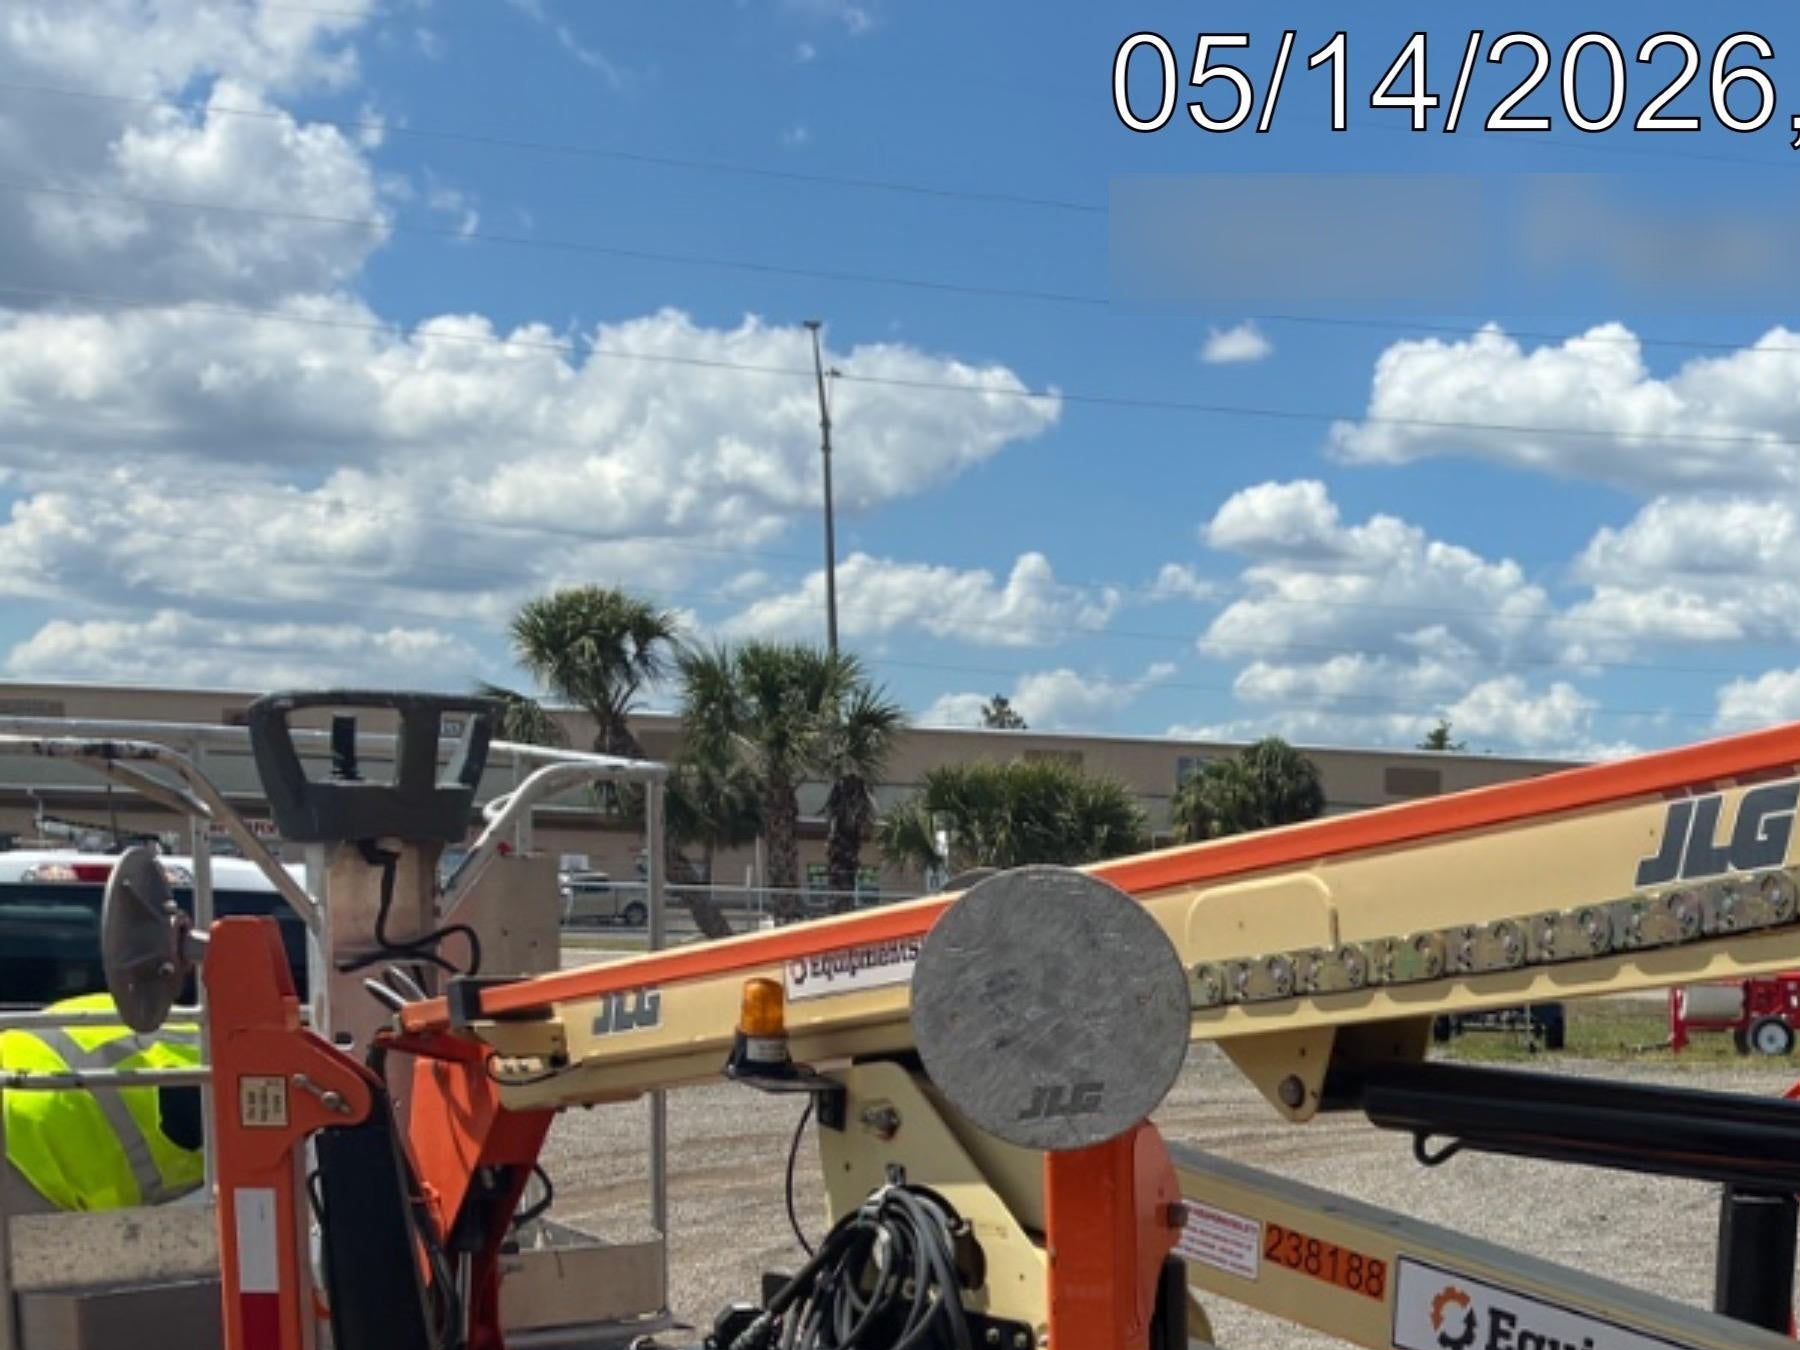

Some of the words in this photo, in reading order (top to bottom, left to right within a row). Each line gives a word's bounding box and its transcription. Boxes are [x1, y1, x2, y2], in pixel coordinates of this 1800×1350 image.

[811, 938, 921, 981] EquipmentS
[591, 988, 662, 1036] JLG
[1018, 1082, 1105, 1120] JLG
[1263, 1223, 1385, 1298] 238188
